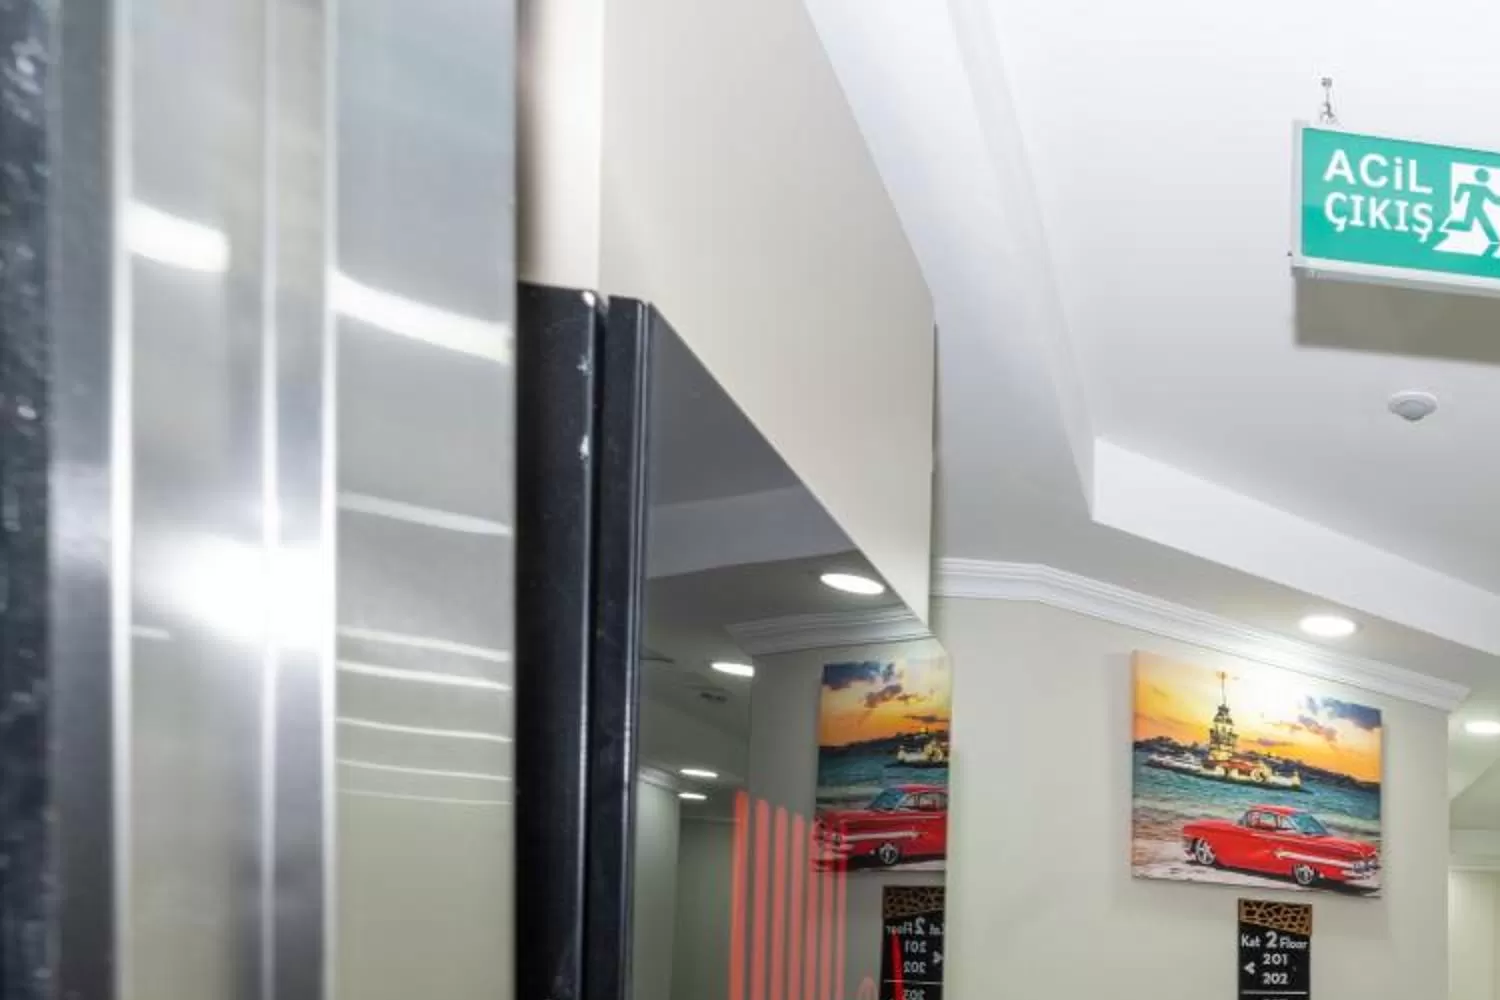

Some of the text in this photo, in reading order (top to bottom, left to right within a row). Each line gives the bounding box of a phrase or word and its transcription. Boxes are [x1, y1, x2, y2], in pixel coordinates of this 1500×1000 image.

[1323, 191, 1434, 243] ÇIKIŞ
[1241, 931, 1308, 950] Kat 2 Floor
[1263, 953, 1288, 966] 201
[1262, 972, 1288, 985] 202
